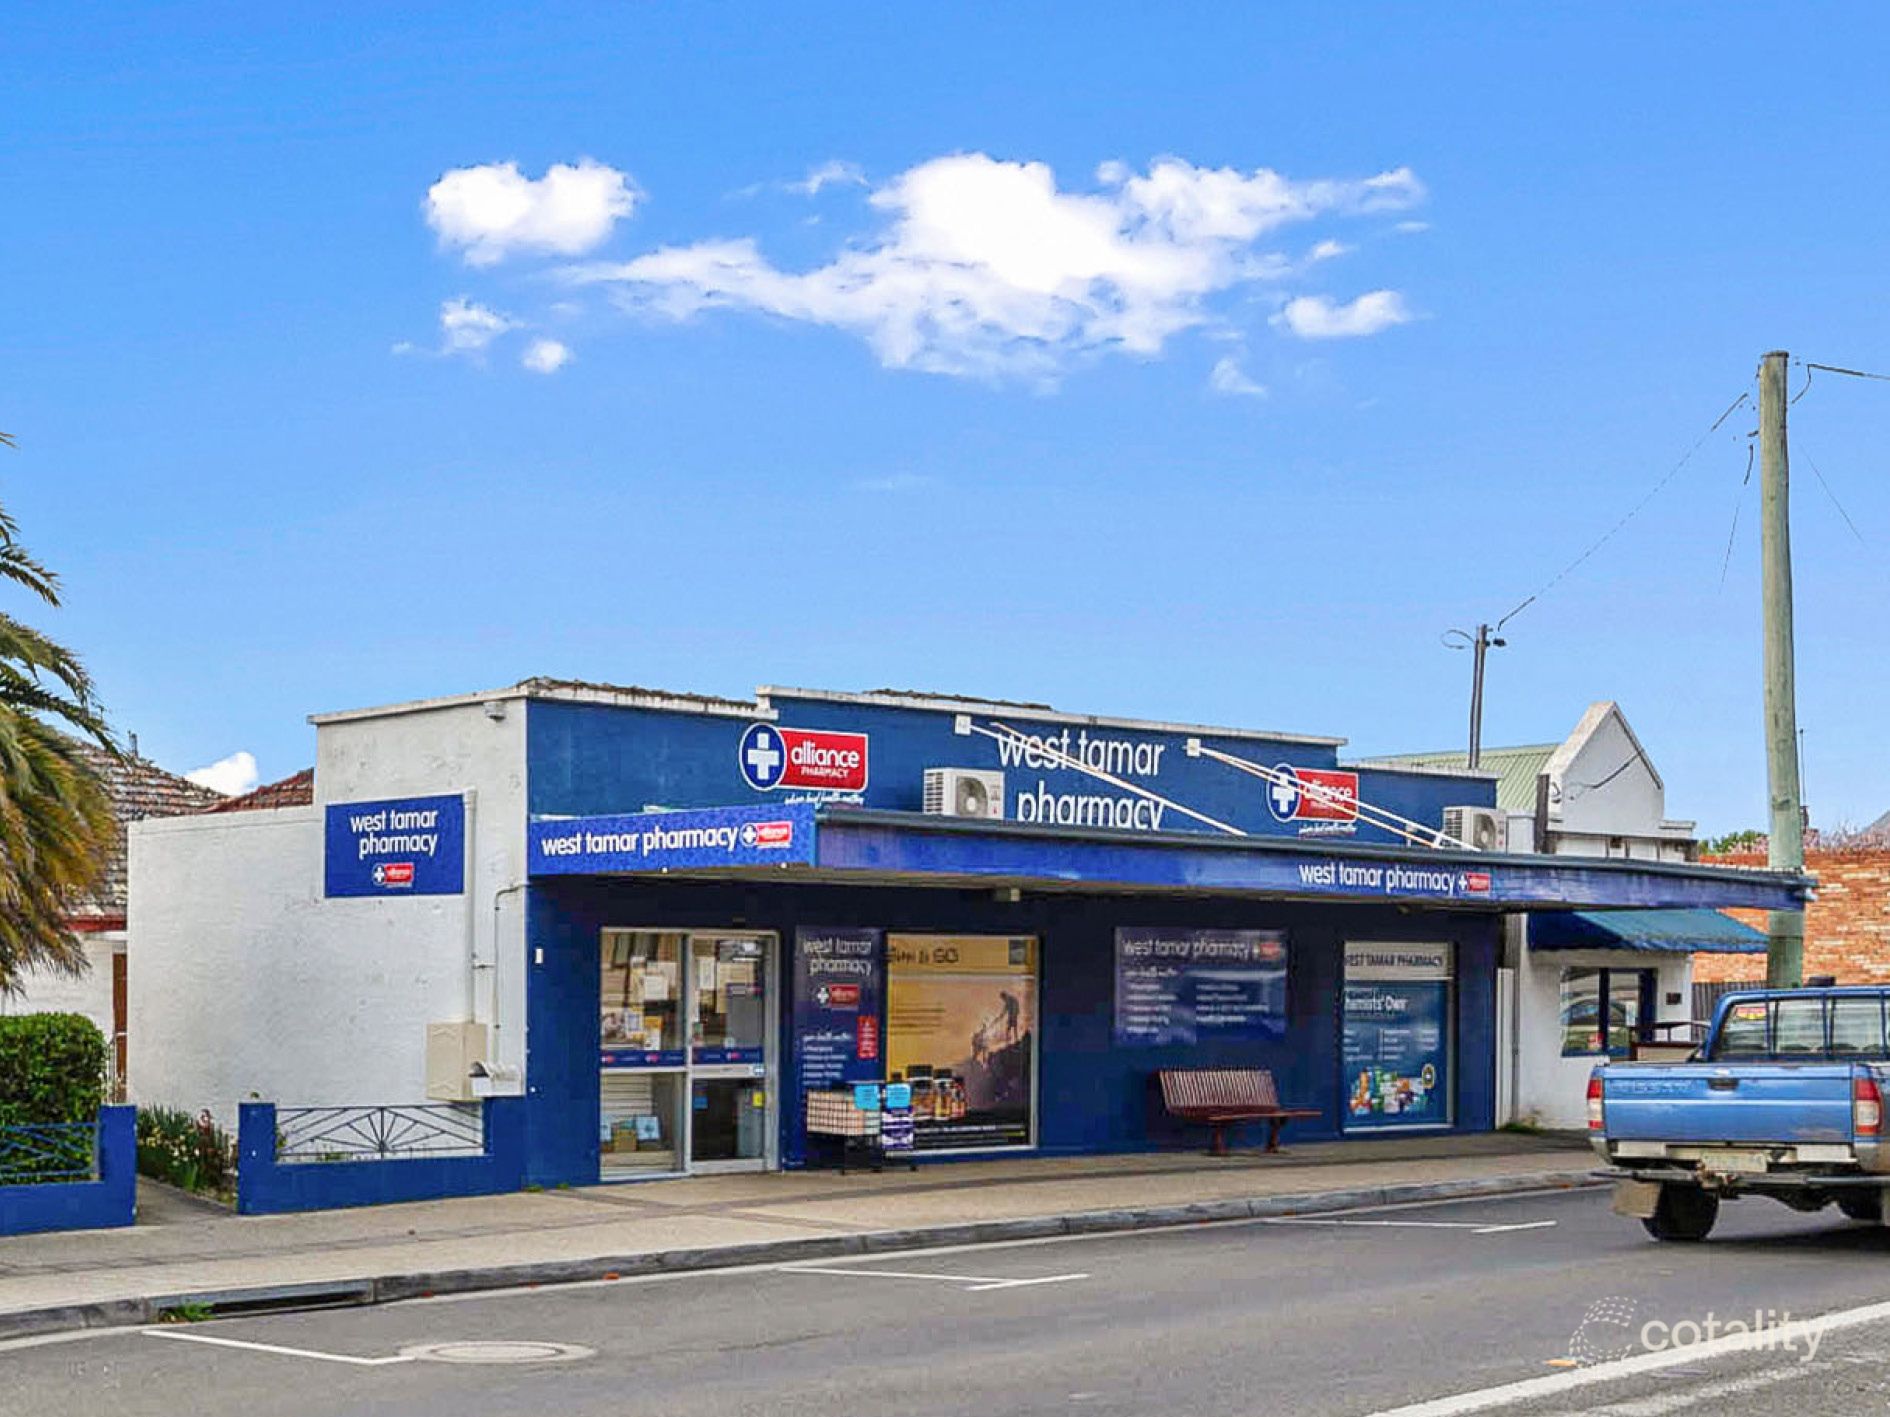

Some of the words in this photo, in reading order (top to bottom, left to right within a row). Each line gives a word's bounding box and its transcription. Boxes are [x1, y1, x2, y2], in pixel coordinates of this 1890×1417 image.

[791, 740, 860, 768] alliance
[998, 728, 1071, 770] west
[1078, 729, 1166, 776] tamar
[801, 766, 849, 778] PHARMACY
[350, 810, 386, 833] west
[390, 809, 439, 830] tamar
[1017, 780, 1165, 832] pharmacy
[358, 831, 438, 860] pharmacy
[541, 833, 581, 856] west
[586, 831, 639, 855] tamar
[643, 825, 738, 857] pharmacy
[1299, 862, 1336, 885] west
[1338, 862, 1383, 887] tamar
[1385, 865, 1456, 897] pharmacy
